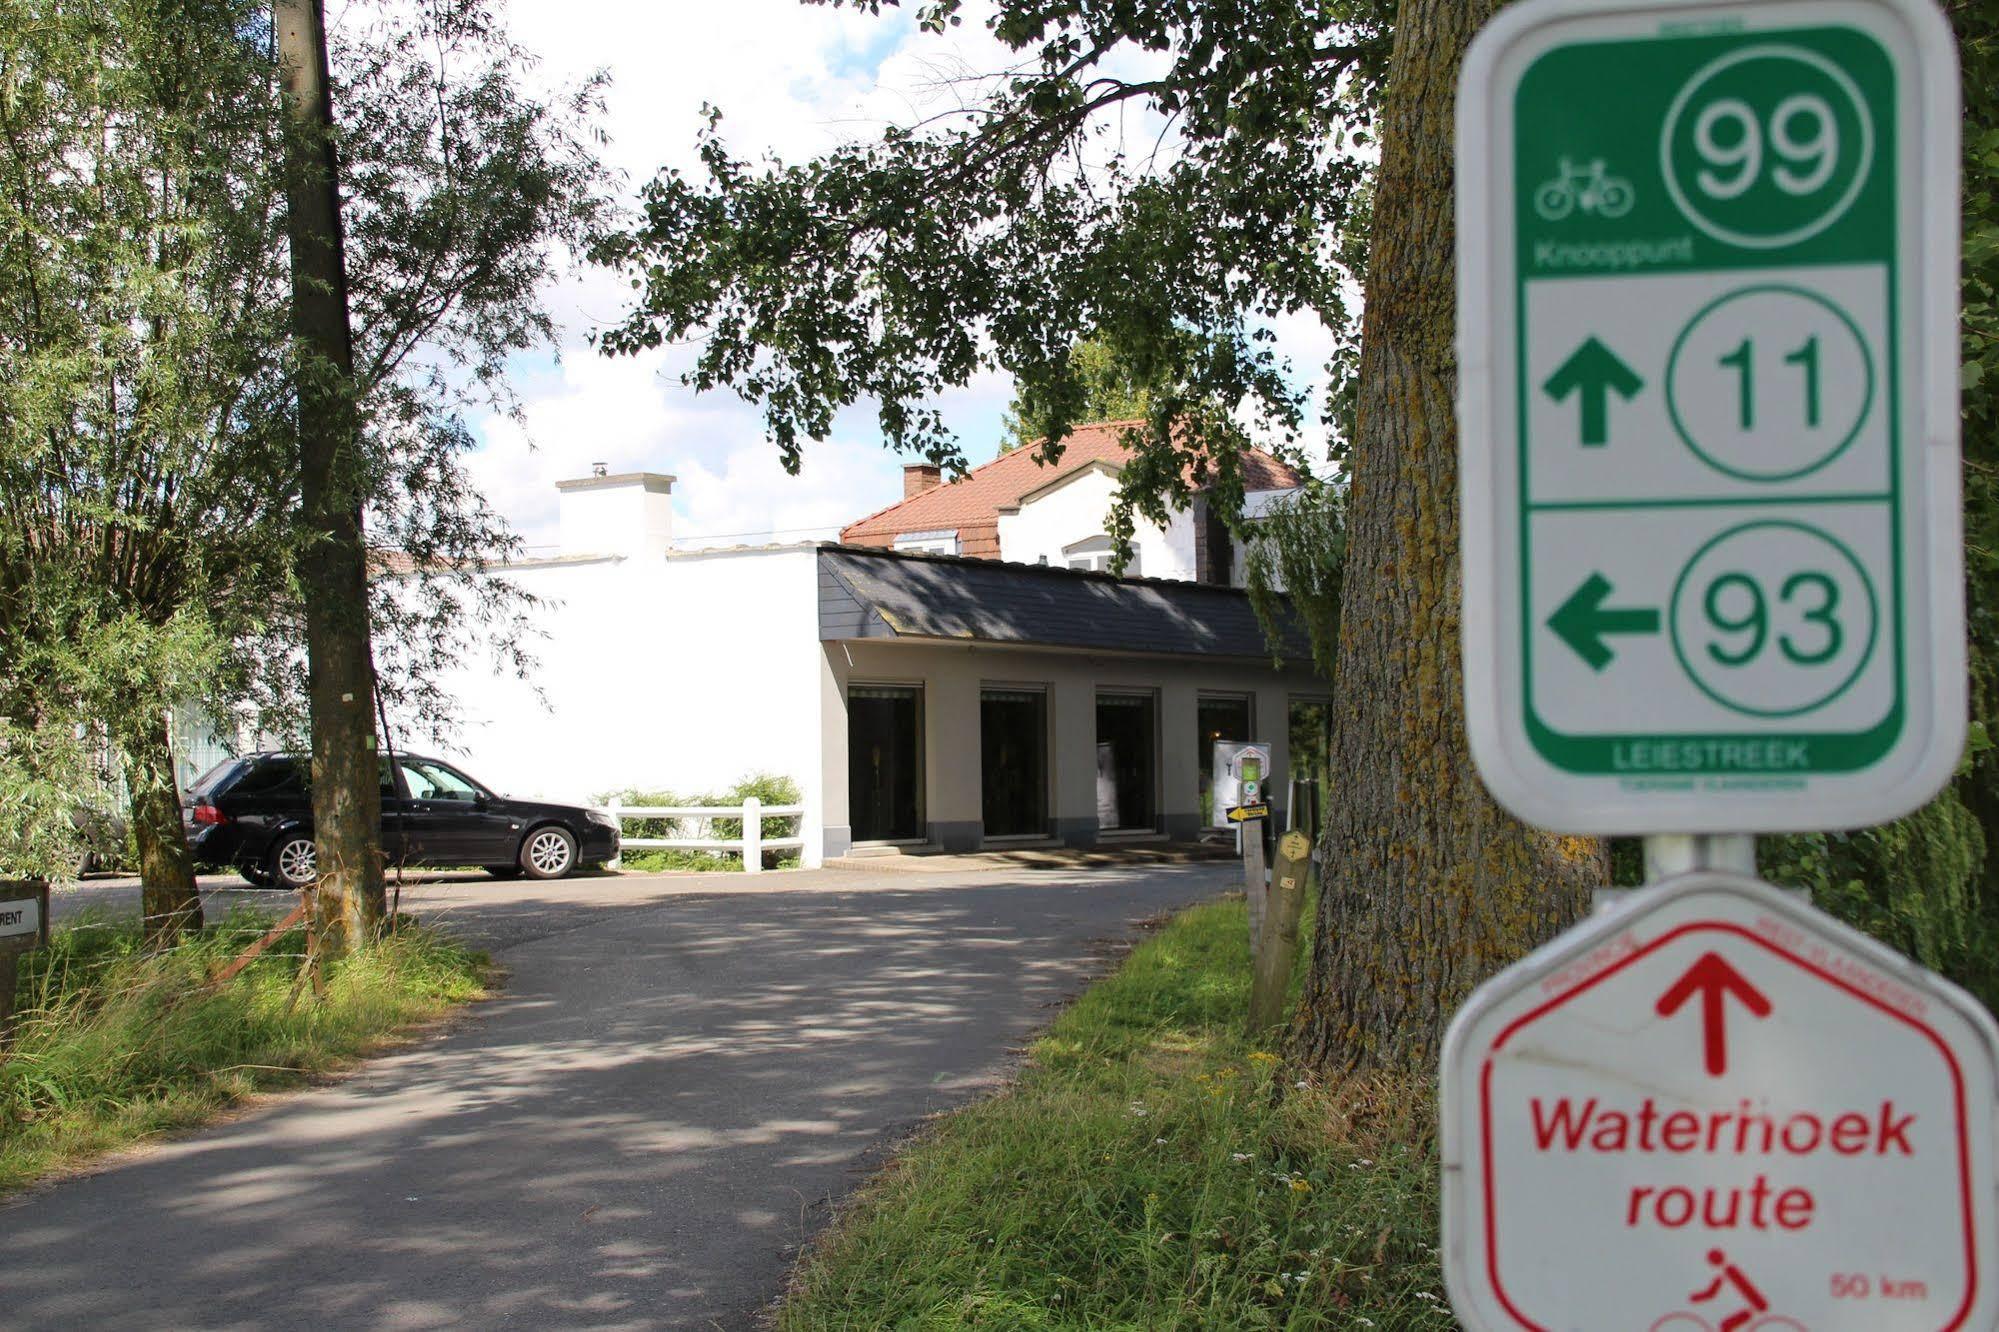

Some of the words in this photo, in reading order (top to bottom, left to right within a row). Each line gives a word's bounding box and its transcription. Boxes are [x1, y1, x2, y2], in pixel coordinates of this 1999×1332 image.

[1693, 94, 1839, 199] 99
[1534, 236, 1694, 268] Knooppunt
[1718, 334, 1819, 430] 11
[1703, 570, 1843, 667] 93
[1613, 740, 1811, 770] LEIESTREEK
[1531, 1096, 1917, 1156] Waterhoek
[1626, 1175, 1815, 1230] route
[1830, 1274, 1869, 1298] 50
[1881, 1275, 1926, 1300] km
